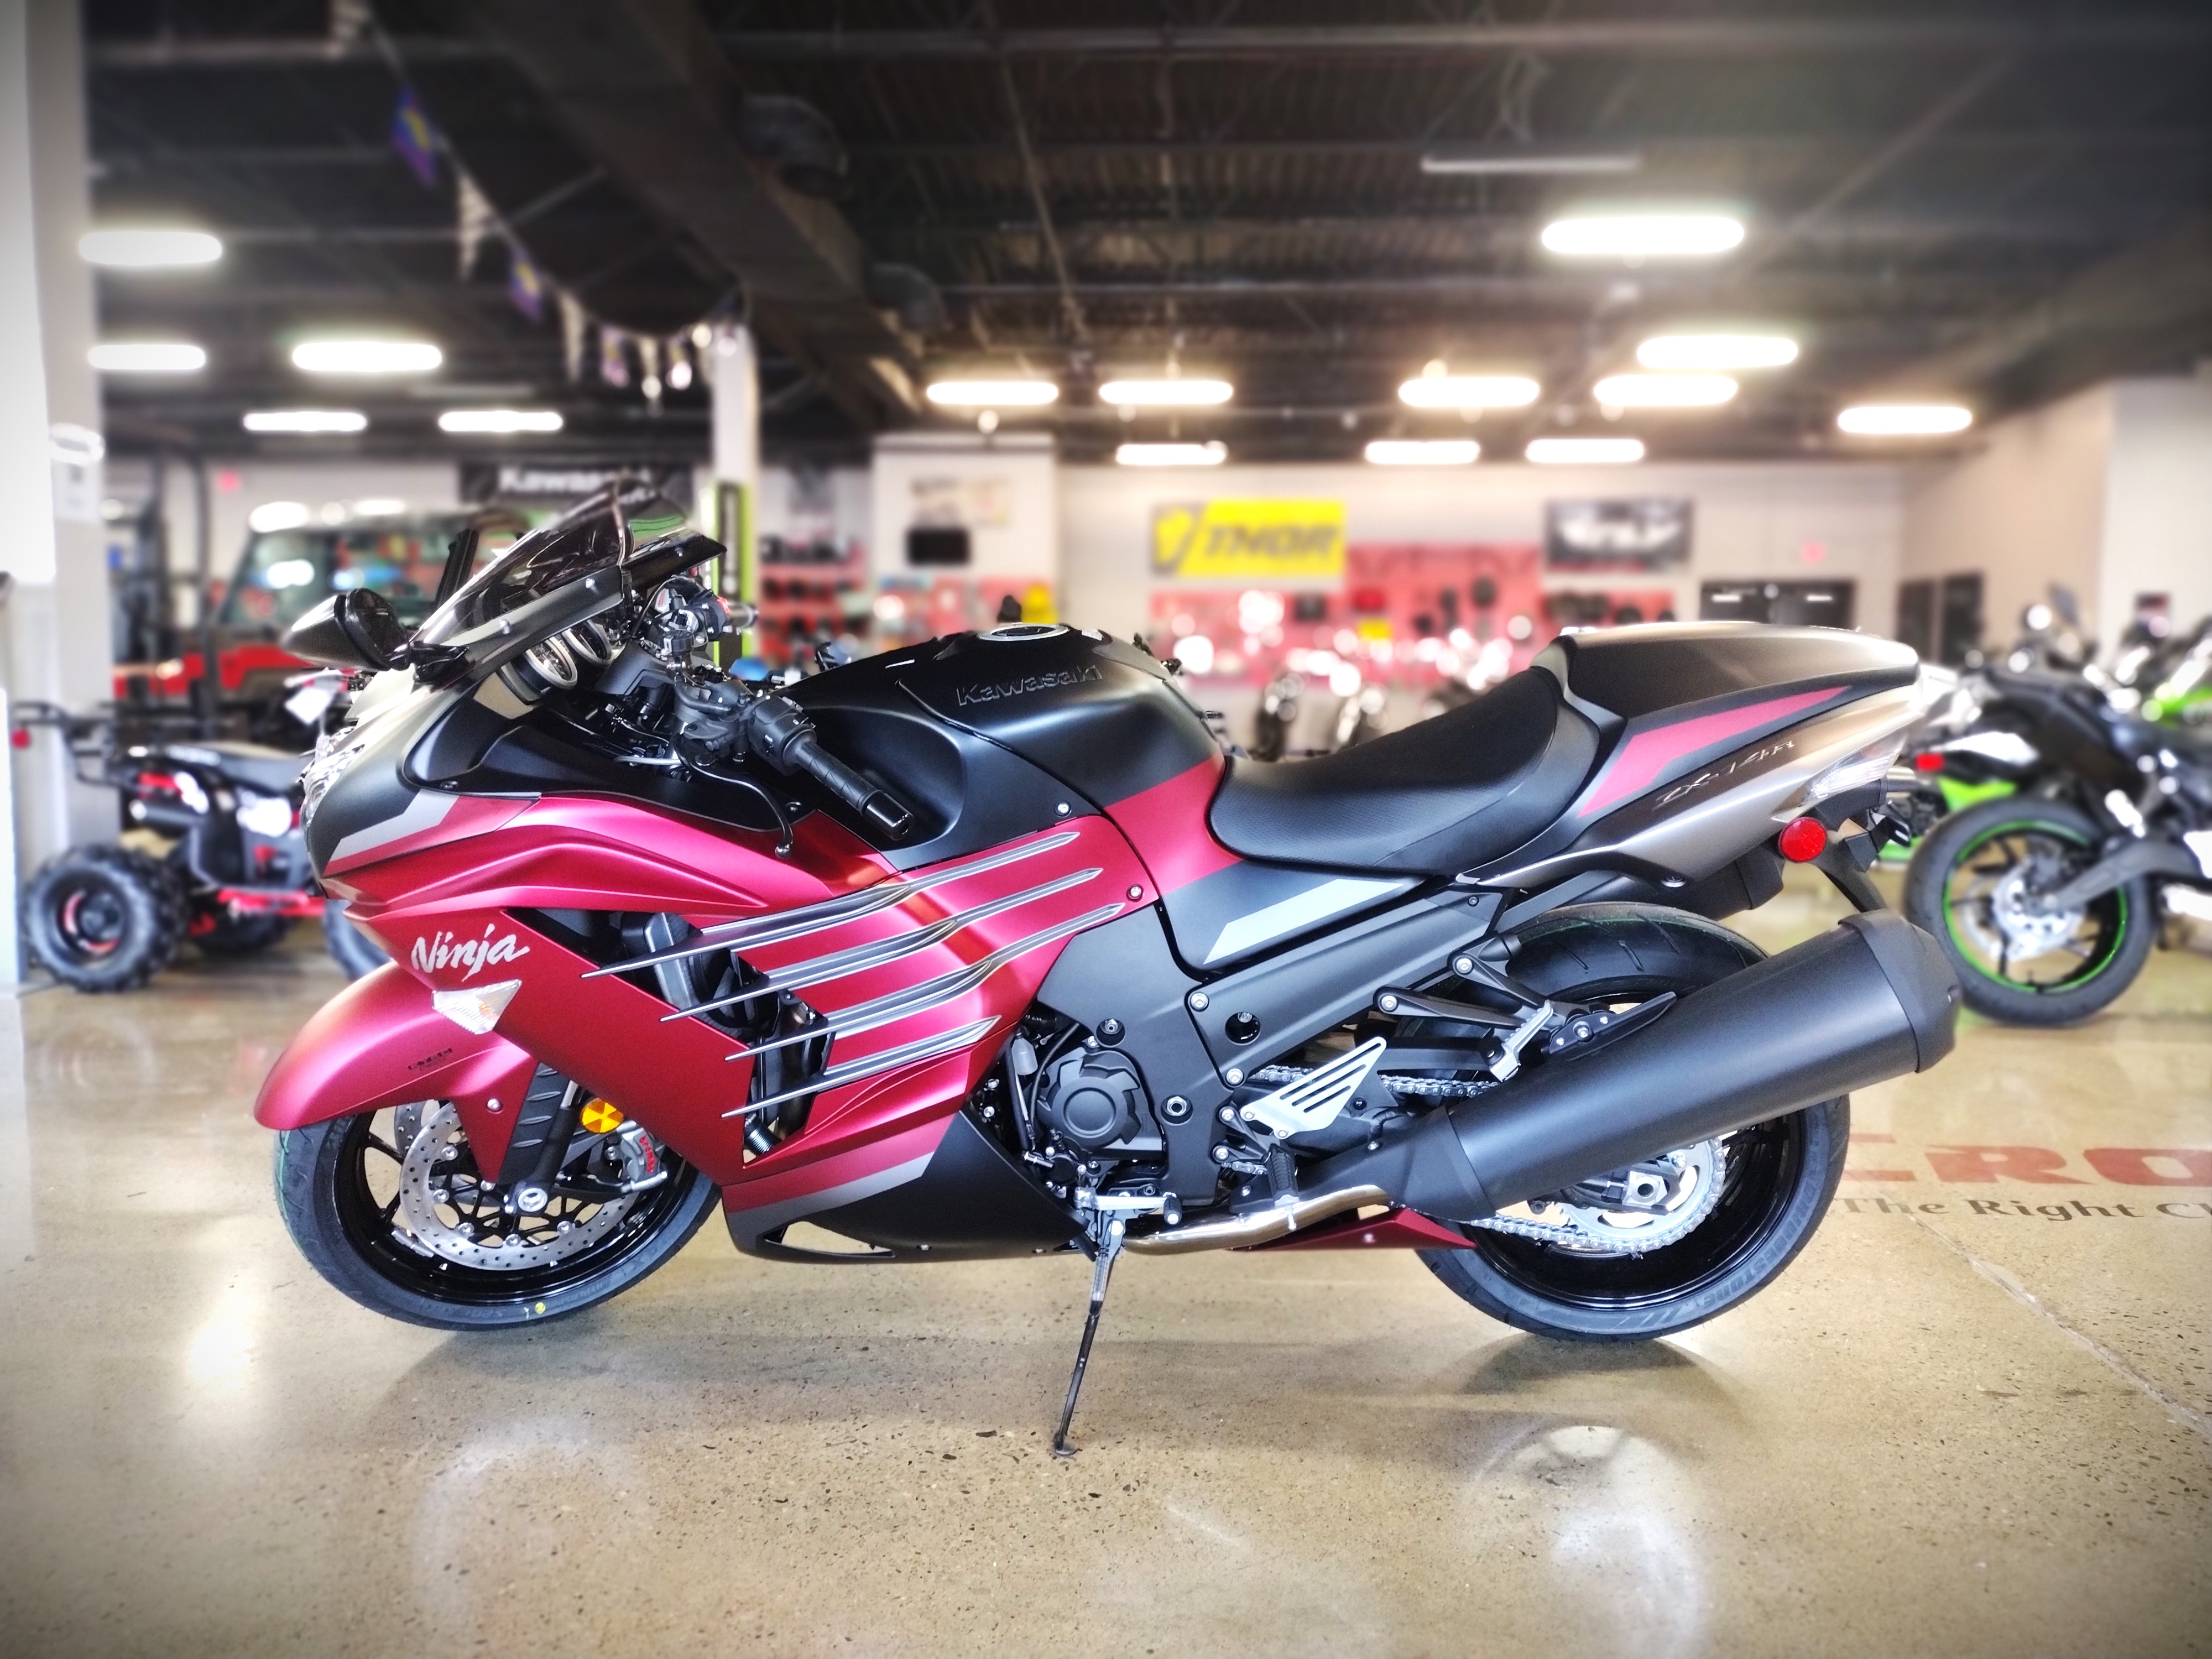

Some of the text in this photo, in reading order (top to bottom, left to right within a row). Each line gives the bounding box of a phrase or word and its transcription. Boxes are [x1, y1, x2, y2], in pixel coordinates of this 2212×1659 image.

[956, 664, 1103, 706] Kawasaki
[411, 923, 530, 982] Ninja
[1833, 1198, 1950, 1214] The
[1966, 1199, 2145, 1221] Right
[1702, 1179, 1819, 1307] BRIDGESTONE
